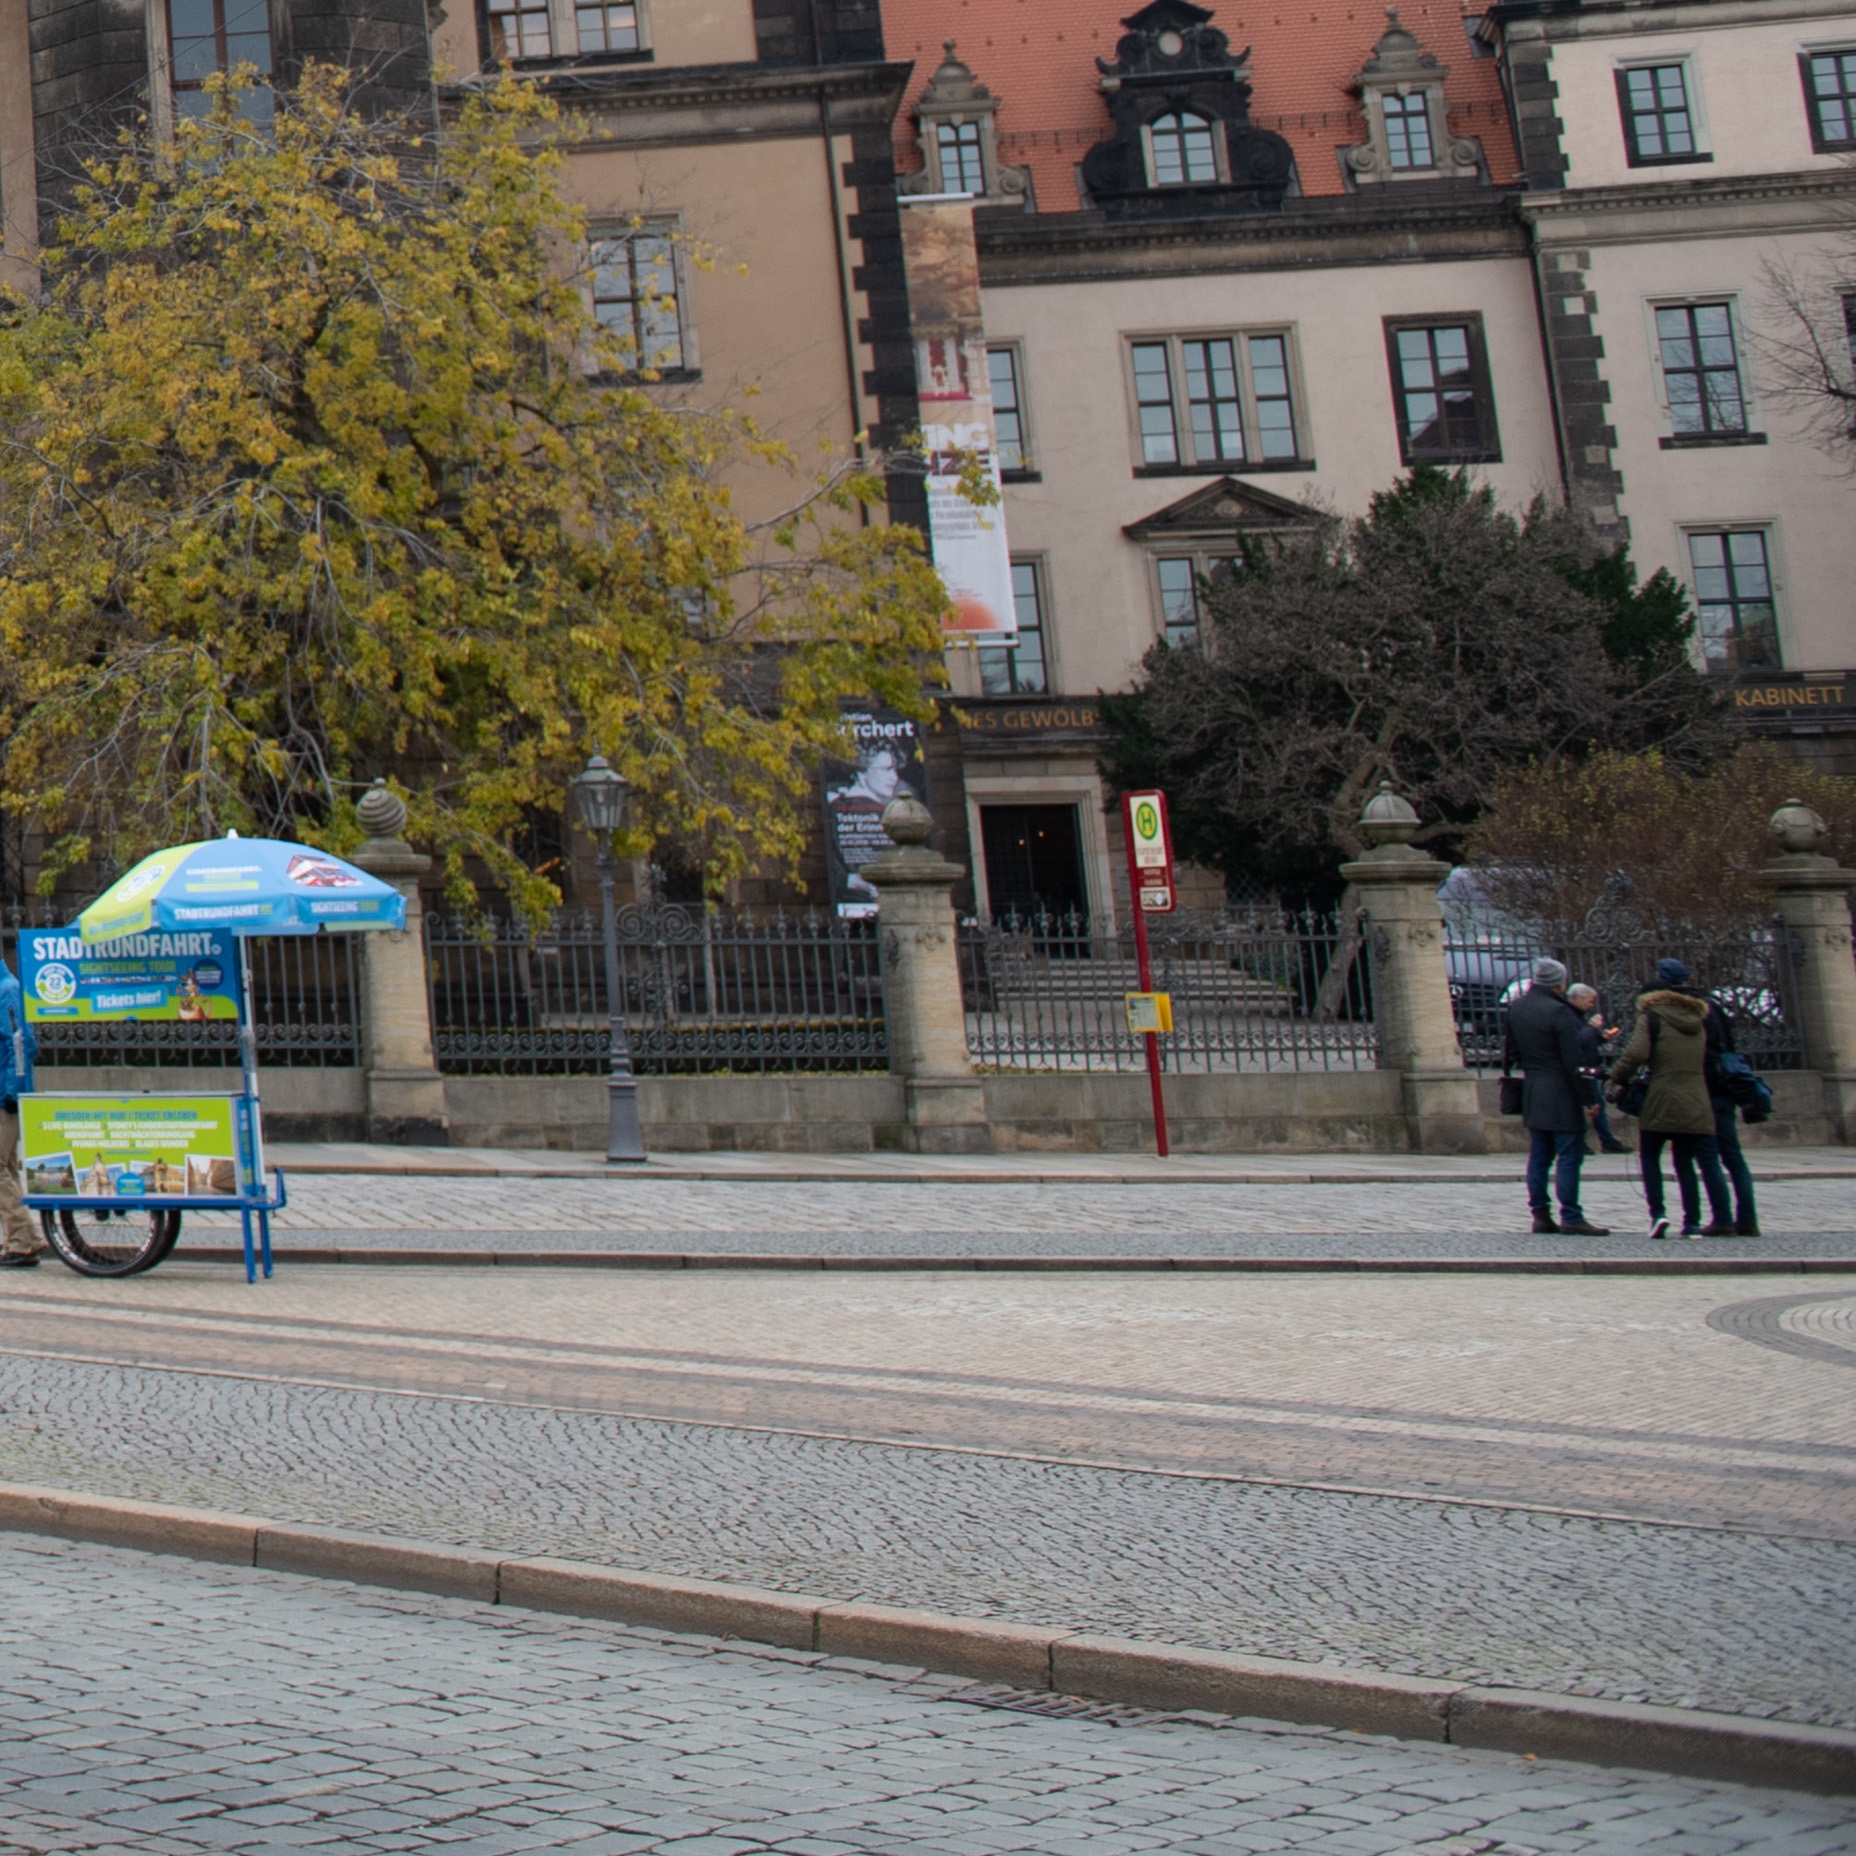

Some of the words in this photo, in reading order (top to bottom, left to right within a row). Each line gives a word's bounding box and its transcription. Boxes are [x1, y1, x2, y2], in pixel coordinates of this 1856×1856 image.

[1734, 686, 1845, 707] KABINETT
[836, 813, 880, 823] Tektonik
[837, 823, 855, 833] der
[856, 823, 884, 833] Erinn
[96, 994, 135, 1008] Tickets
[135, 990, 162, 1005] hier!
